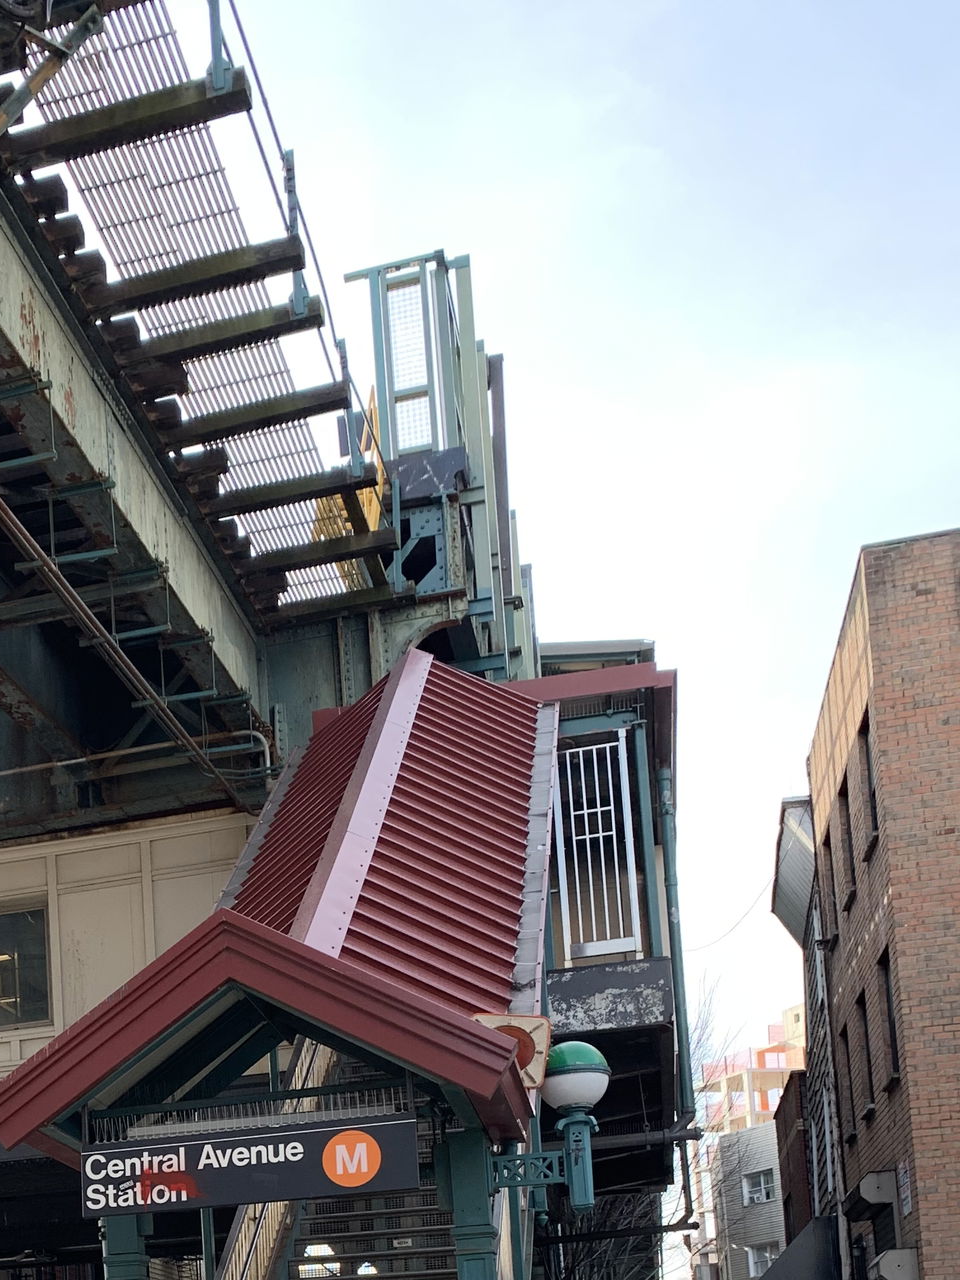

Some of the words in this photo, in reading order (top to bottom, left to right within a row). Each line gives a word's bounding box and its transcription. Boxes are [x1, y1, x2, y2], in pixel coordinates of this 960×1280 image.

[85, 1147, 186, 1181] Central
[197, 1141, 304, 1170] Avenue
[335, 1142, 369, 1175] M
[86, 1178, 188, 1210] Station
